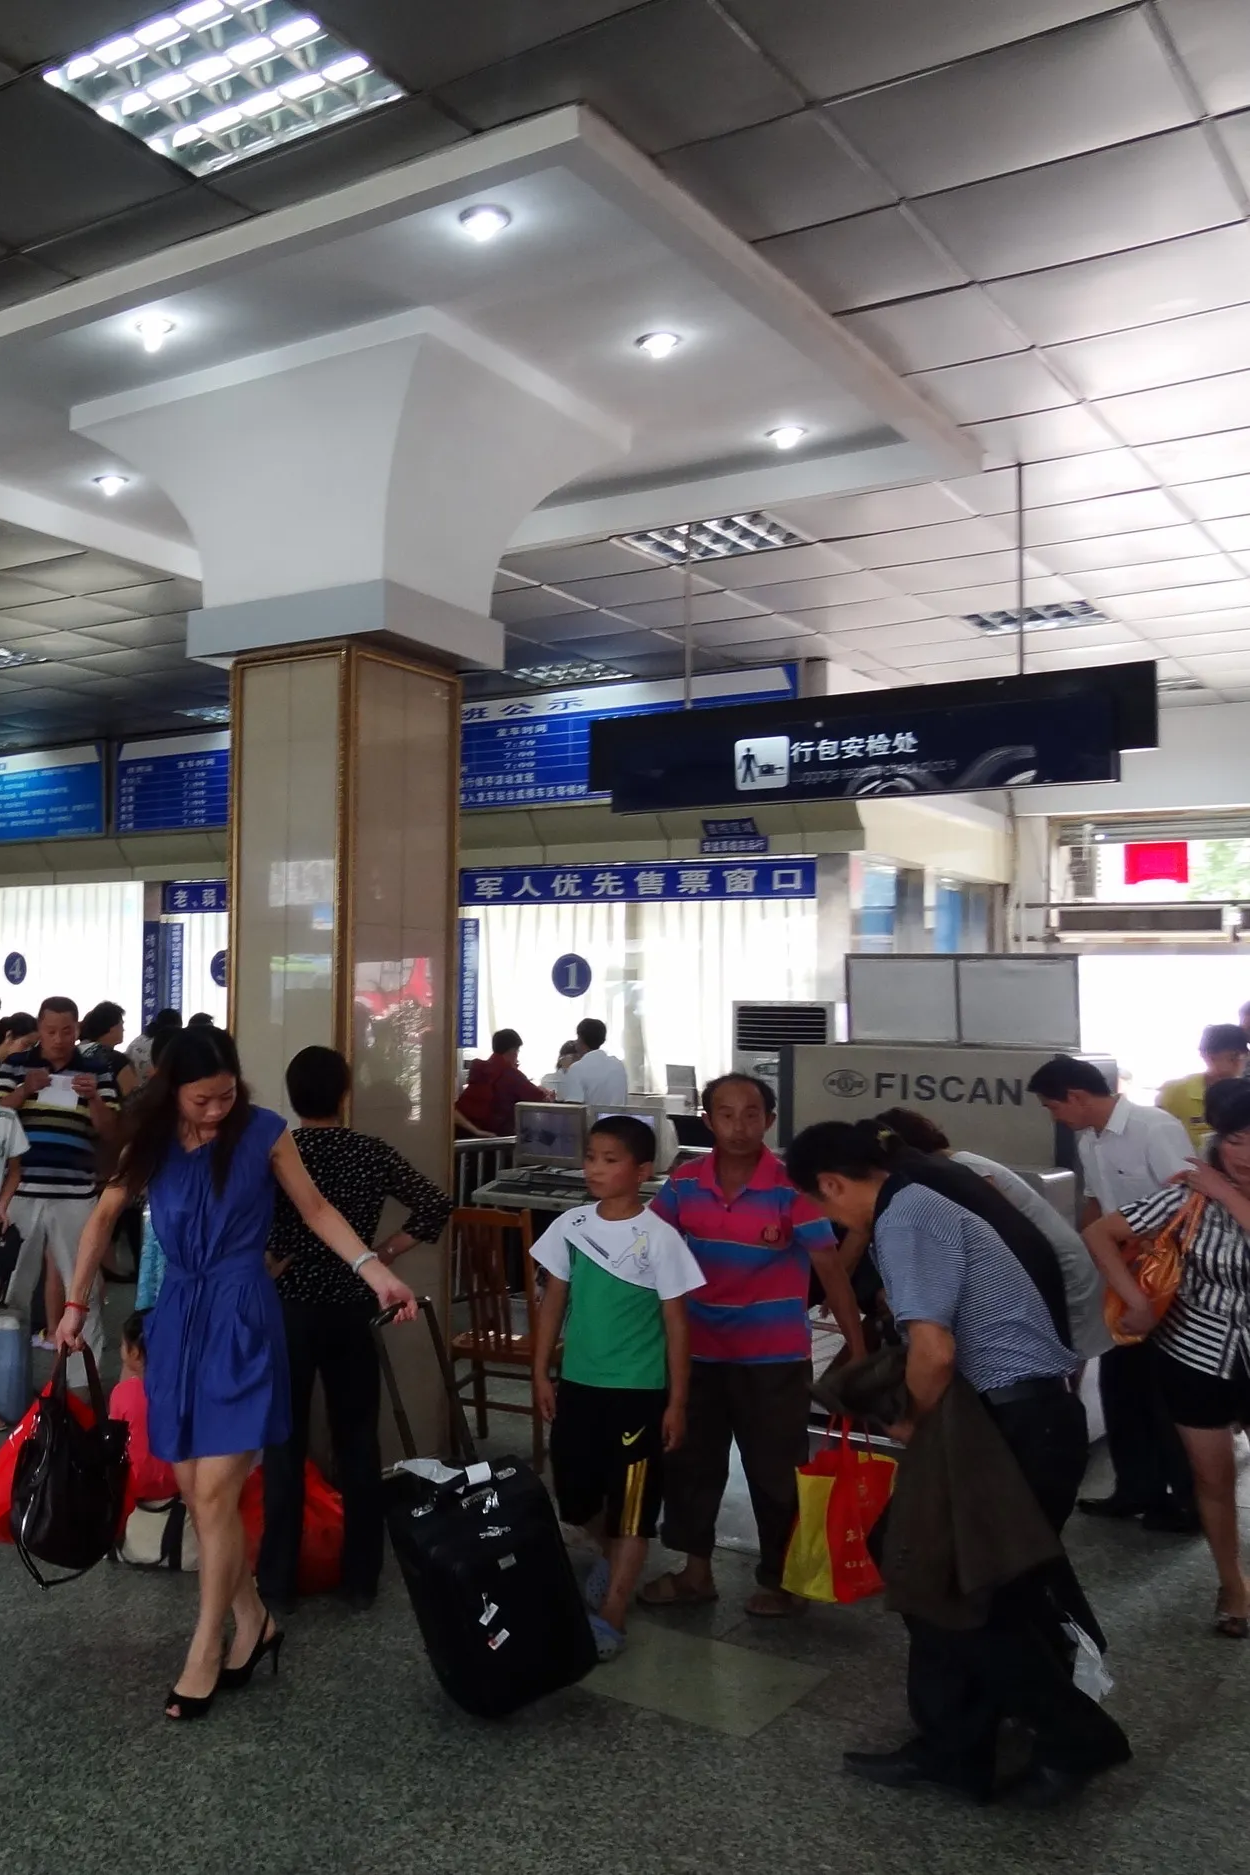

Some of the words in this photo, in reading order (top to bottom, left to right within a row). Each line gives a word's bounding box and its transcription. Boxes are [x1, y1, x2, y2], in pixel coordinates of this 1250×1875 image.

[790, 731, 918, 763] 行包安检处
[474, 867, 804, 899] 军人优先售票窗口
[9, 957, 22, 979] 4
[564, 963, 581, 990] 1
[874, 1072, 1024, 1106] FISCAN
